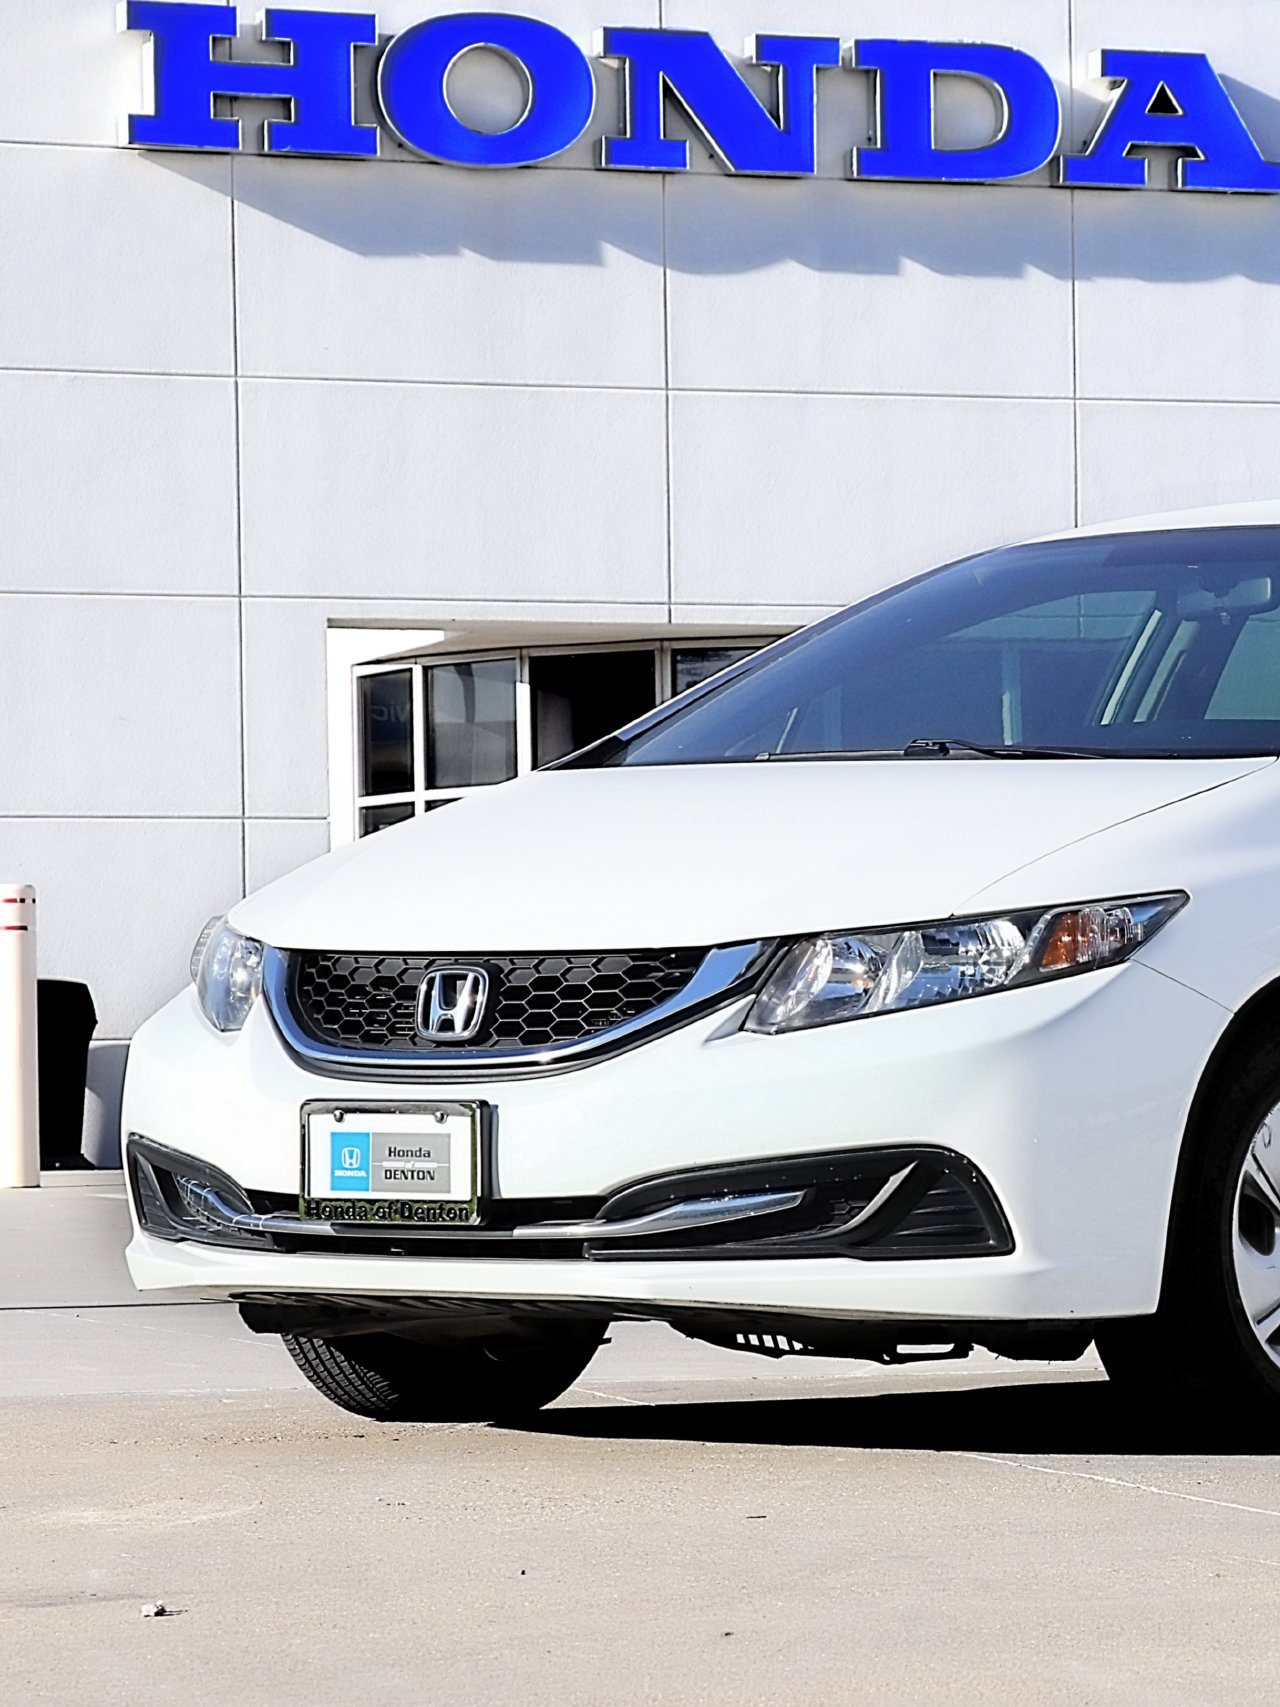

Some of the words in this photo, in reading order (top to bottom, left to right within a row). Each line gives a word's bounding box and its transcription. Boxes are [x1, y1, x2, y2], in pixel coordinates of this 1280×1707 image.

[388, 1146, 431, 1158] Honda
[333, 1169, 367, 1177] HONDA
[384, 1169, 435, 1181] DENTON
[305, 1199, 368, 1219] Honda
[374, 1201, 396, 1220] of
[399, 1201, 469, 1222] Denton
